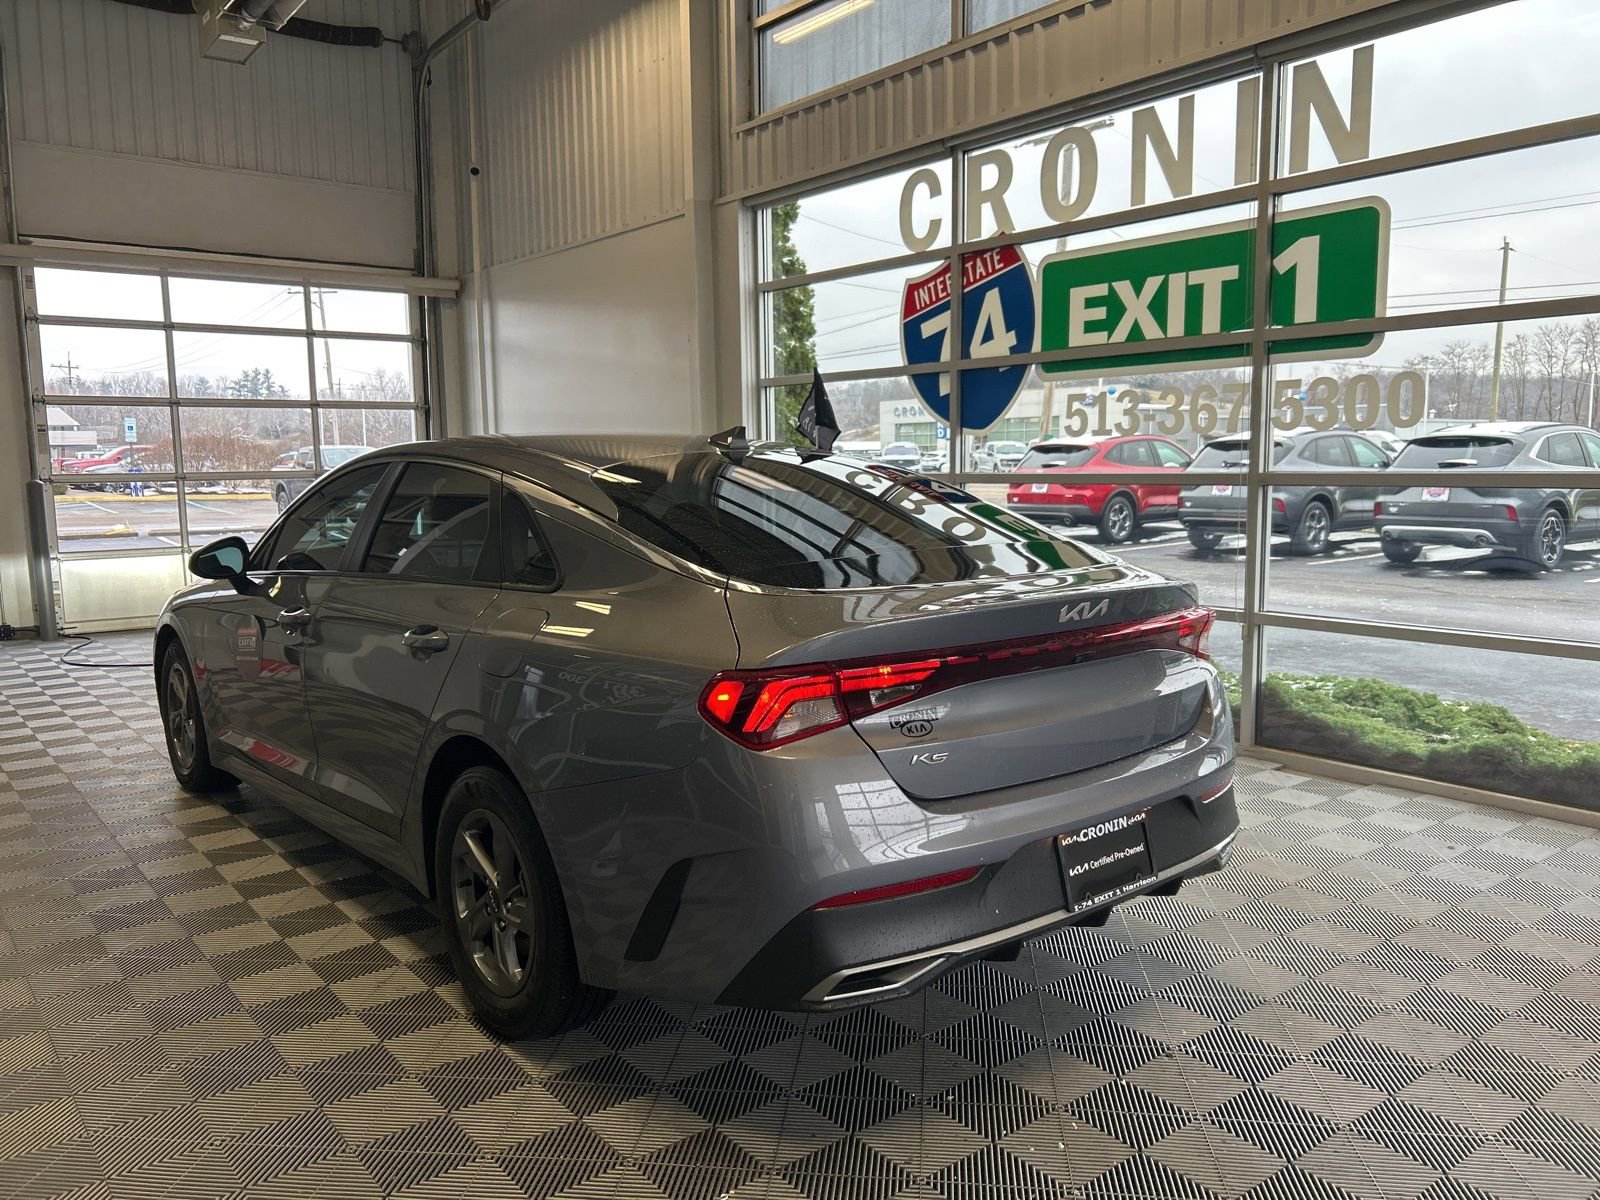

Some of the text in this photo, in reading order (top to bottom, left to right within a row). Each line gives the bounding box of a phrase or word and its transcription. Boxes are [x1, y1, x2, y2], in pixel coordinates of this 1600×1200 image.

[899, 43, 1374, 253] CRONIN
[1068, 235, 1320, 348] EXIT 1
[920, 287, 1017, 397] 74
[1058, 599, 1109, 623] KIA
[890, 708, 936, 728] CRONIN
[906, 723, 928, 735] KIA
[909, 752, 949, 766] K5
[1079, 816, 1127, 842] CRONIN
[1069, 843, 1145, 877] KIA Certified Pre-Owned
[1074, 899, 1093, 912] I-74
[1093, 890, 1114, 903] EXIT
[1122, 875, 1157, 892] Harrison
